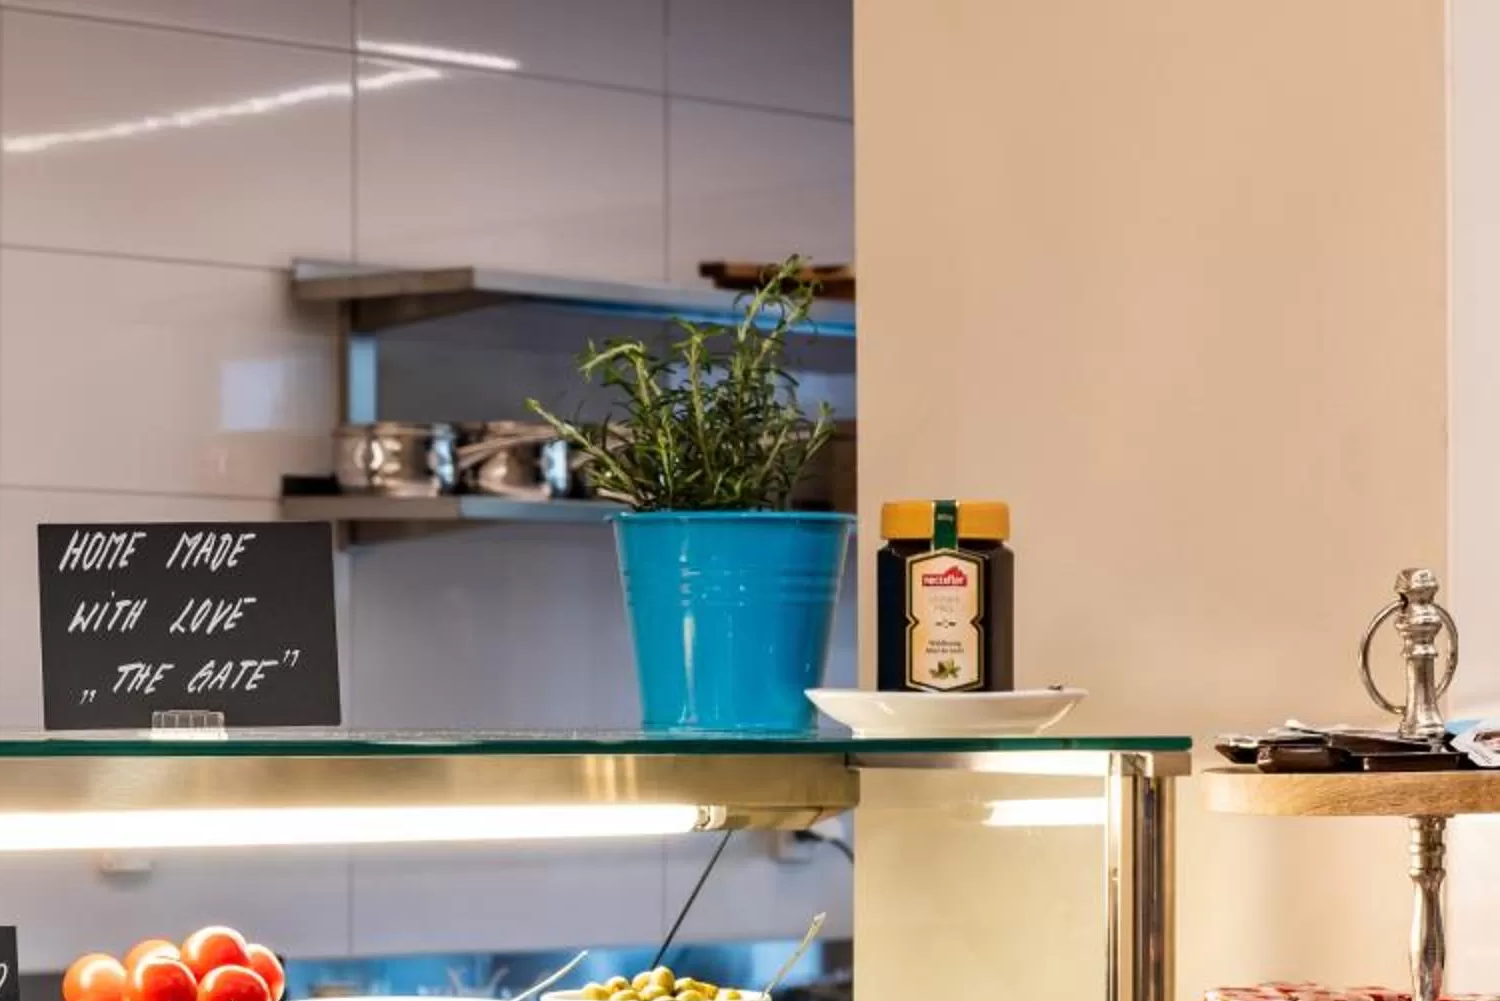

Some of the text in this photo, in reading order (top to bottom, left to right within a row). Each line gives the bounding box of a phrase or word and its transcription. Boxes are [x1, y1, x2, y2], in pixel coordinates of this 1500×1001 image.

[59, 530, 256, 572] HOME MADE
[169, 597, 257, 635] LOVE
